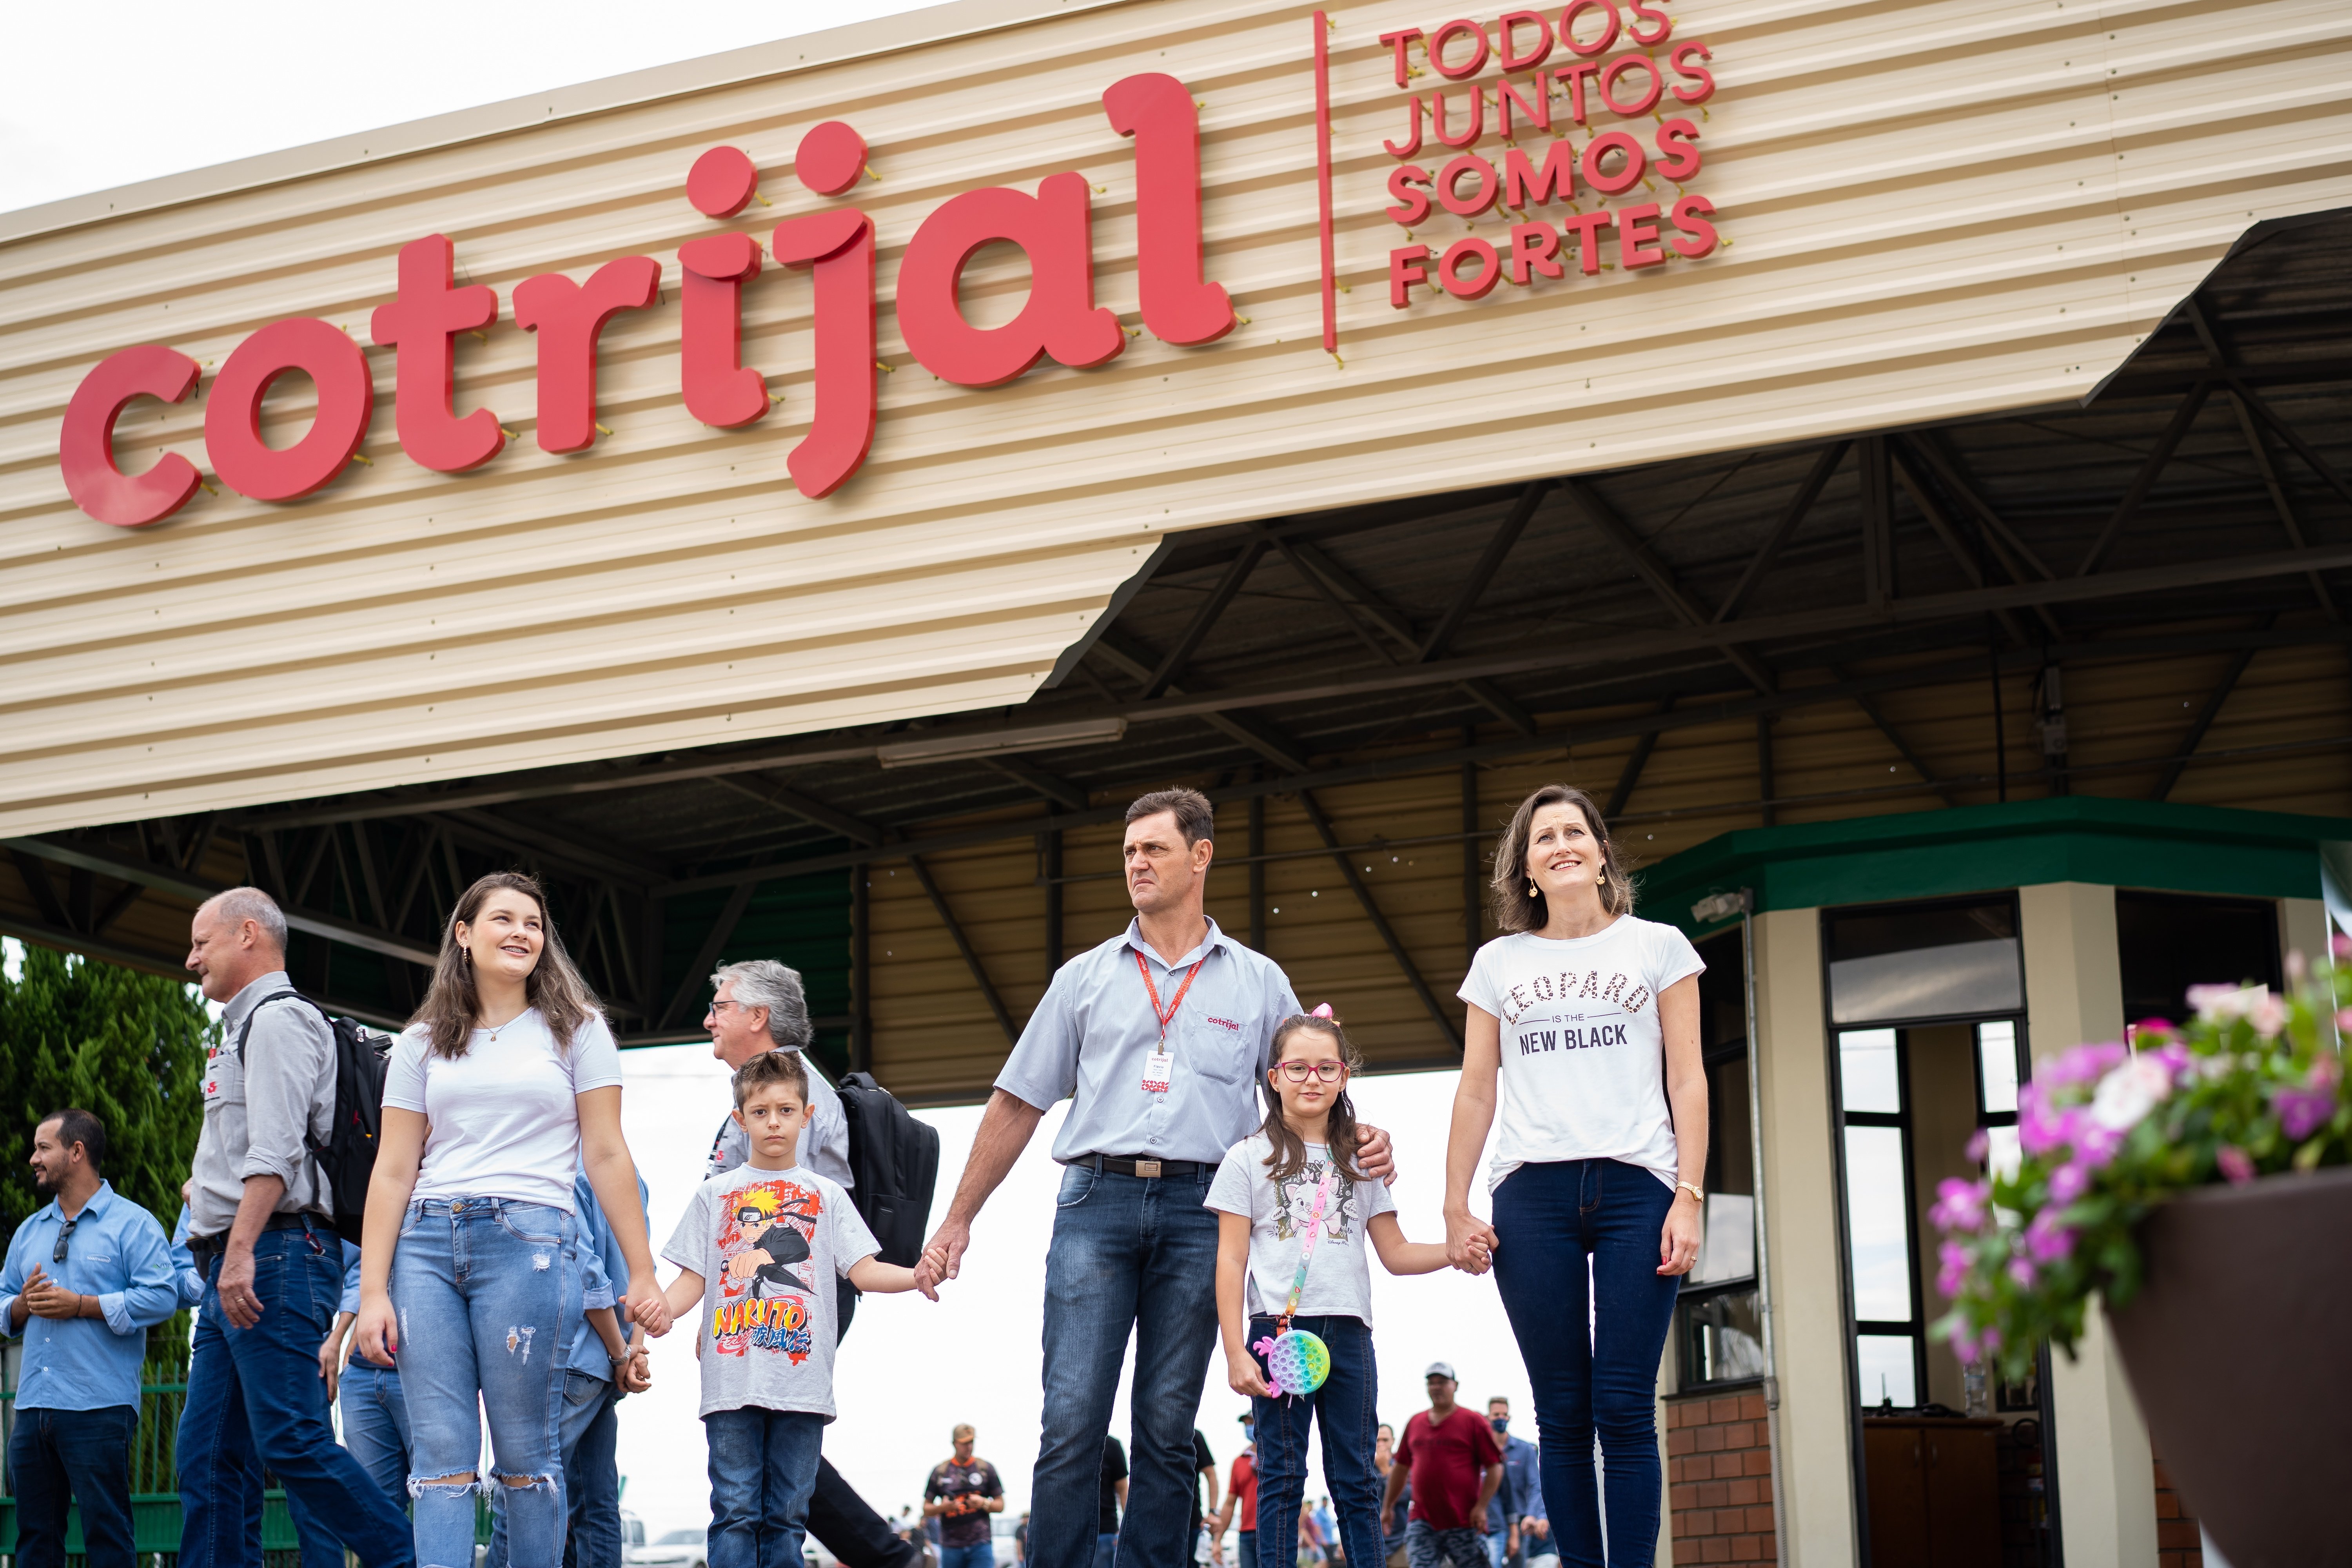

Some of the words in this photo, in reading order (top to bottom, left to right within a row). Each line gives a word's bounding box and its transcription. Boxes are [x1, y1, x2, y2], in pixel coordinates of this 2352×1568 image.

[1379, 0, 1671, 87] TODOS
[1384, 40, 1715, 160] JUNTOS
[1386, 118, 1702, 226] SOMOS
[1390, 195, 1718, 308] FORTES
[60, 73, 1237, 525] cotrijal
[1166, 1004, 1176, 1019] cotrijal
[1503, 971, 1648, 1025] LEOPARD
[1208, 1017, 1239, 1031] cotrijal
[1564, 1014, 1584, 1022] THE
[1519, 1030, 1556, 1056] NEW
[1564, 1024, 1628, 1050] BLACK
[1279, 1186, 1289, 1206] Precious
[1333, 1172, 1345, 1196] important
[1274, 1208, 1283, 1218] meow!
[713, 1298, 806, 1338] NARUTO
[751, 1322, 811, 1352] 疾風伝
